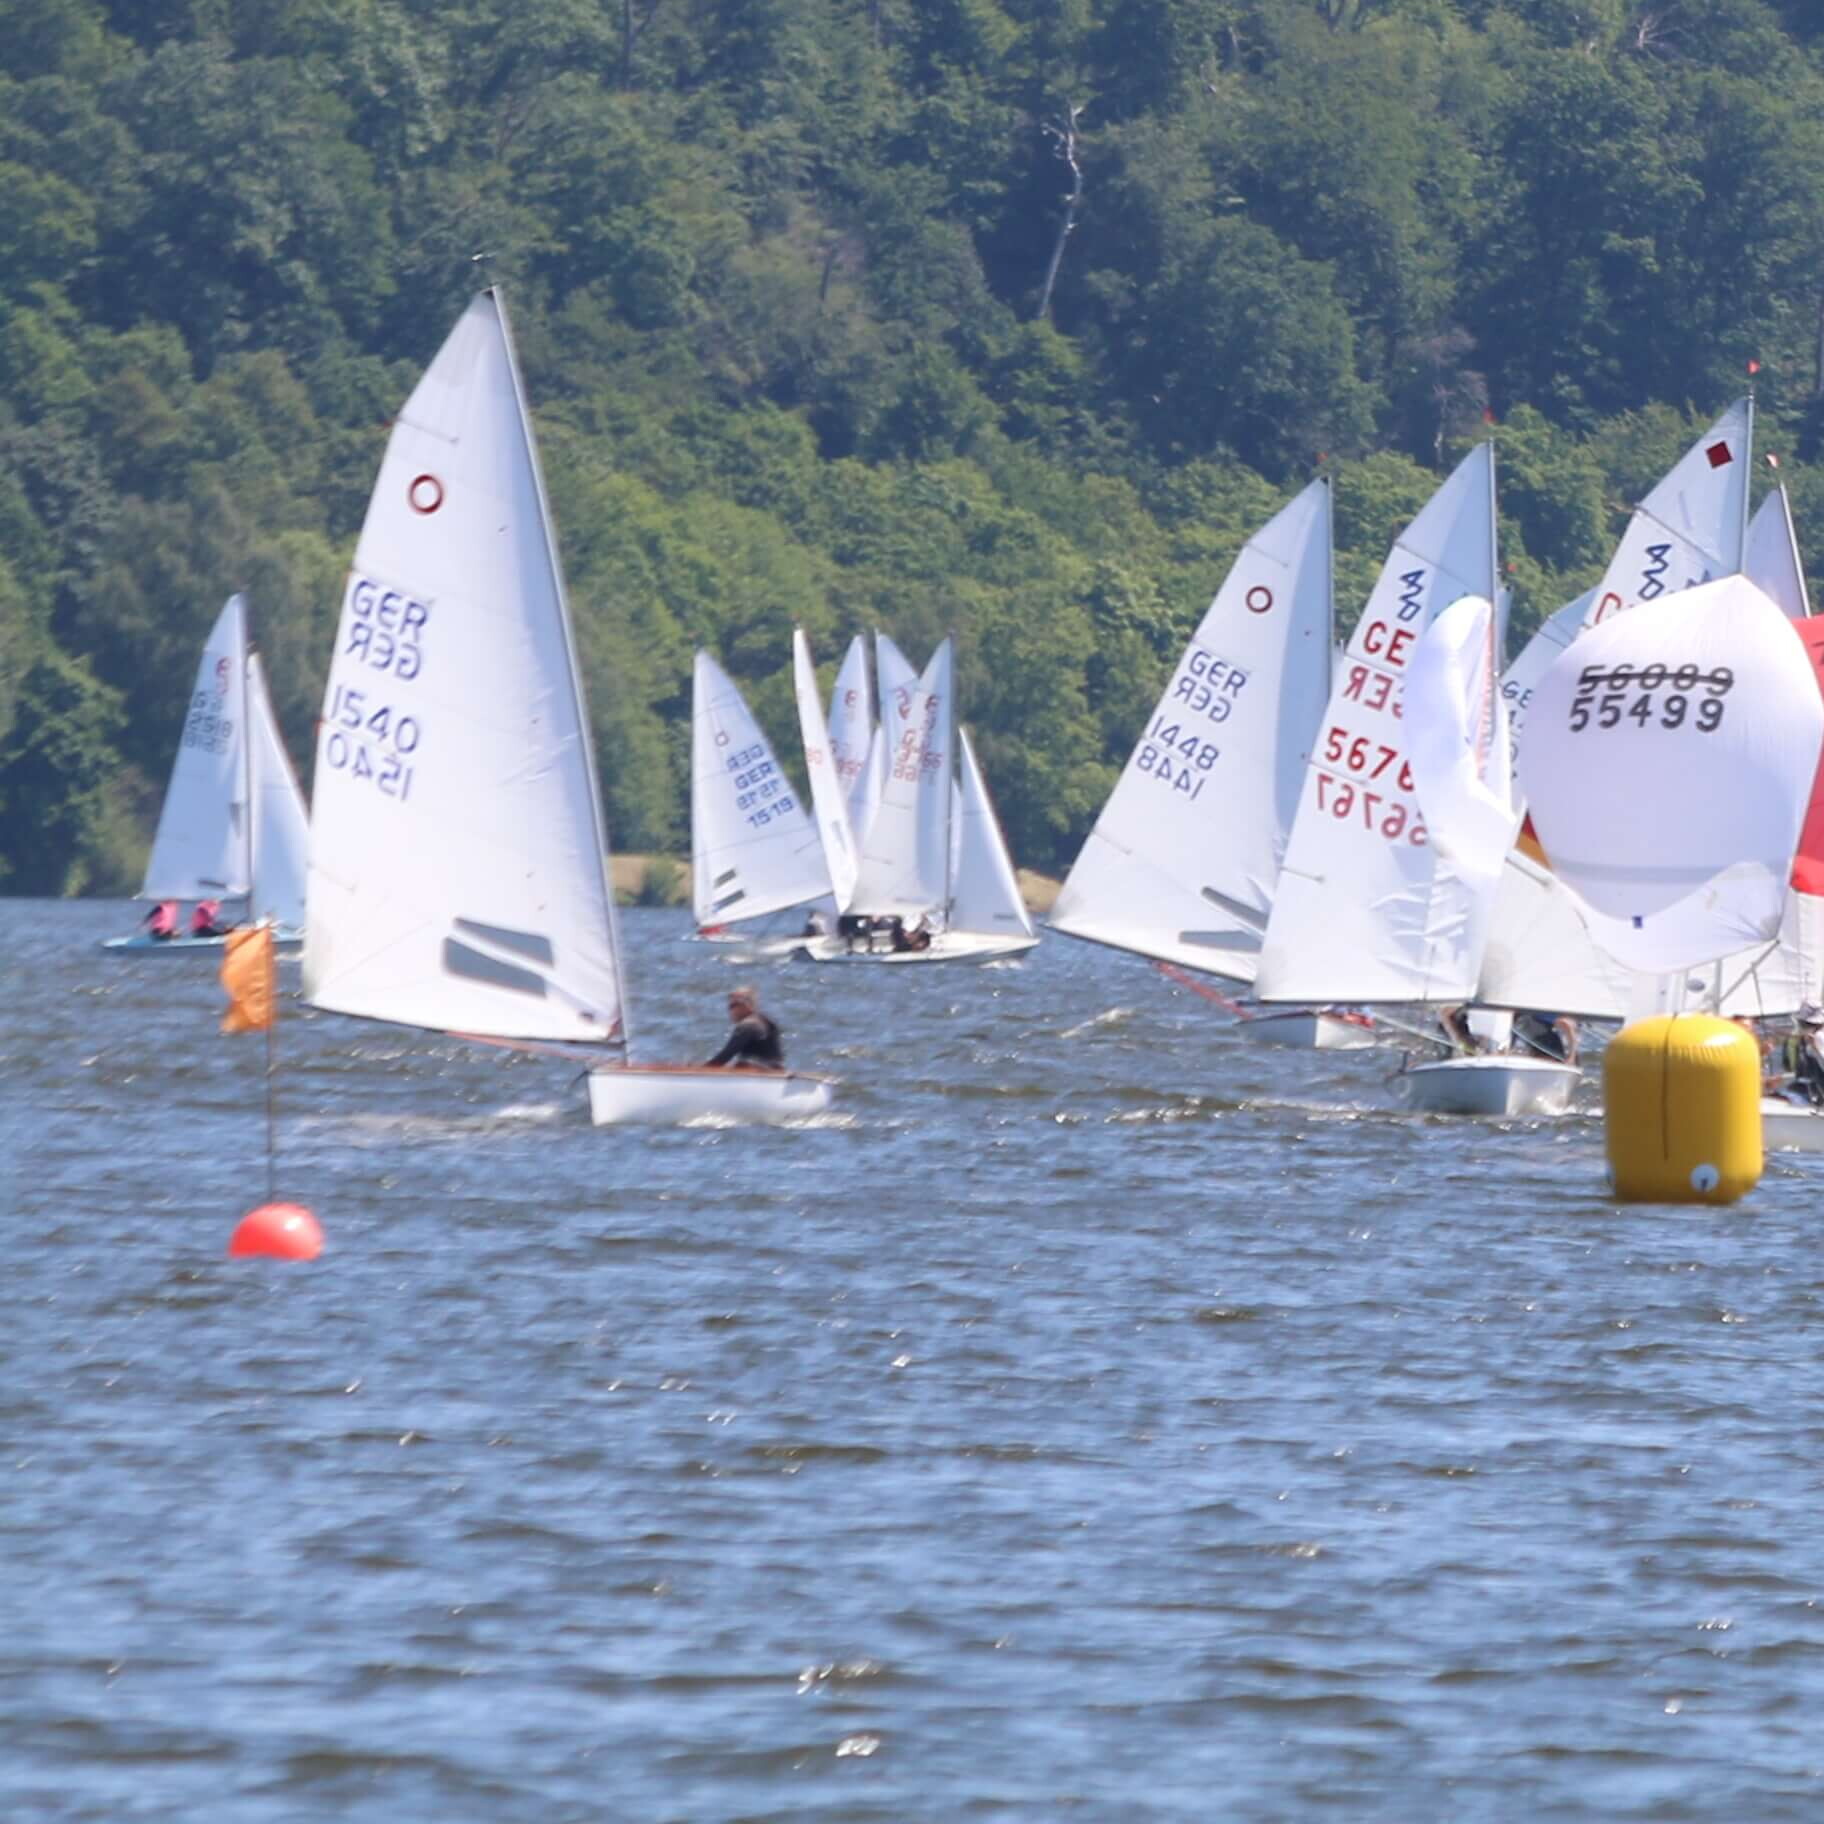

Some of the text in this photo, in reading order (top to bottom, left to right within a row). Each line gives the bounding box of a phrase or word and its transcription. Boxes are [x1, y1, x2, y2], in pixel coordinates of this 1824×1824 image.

[352, 580, 428, 643] GER
[1363, 621, 1416, 667] GE
[1189, 651, 1246, 698] GER
[331, 685, 419, 753] 1540
[1568, 694, 1724, 732] 55499
[1150, 715, 1219, 771] 1448
[735, 762, 772, 789] GER
[750, 798, 793, 827] 1519
